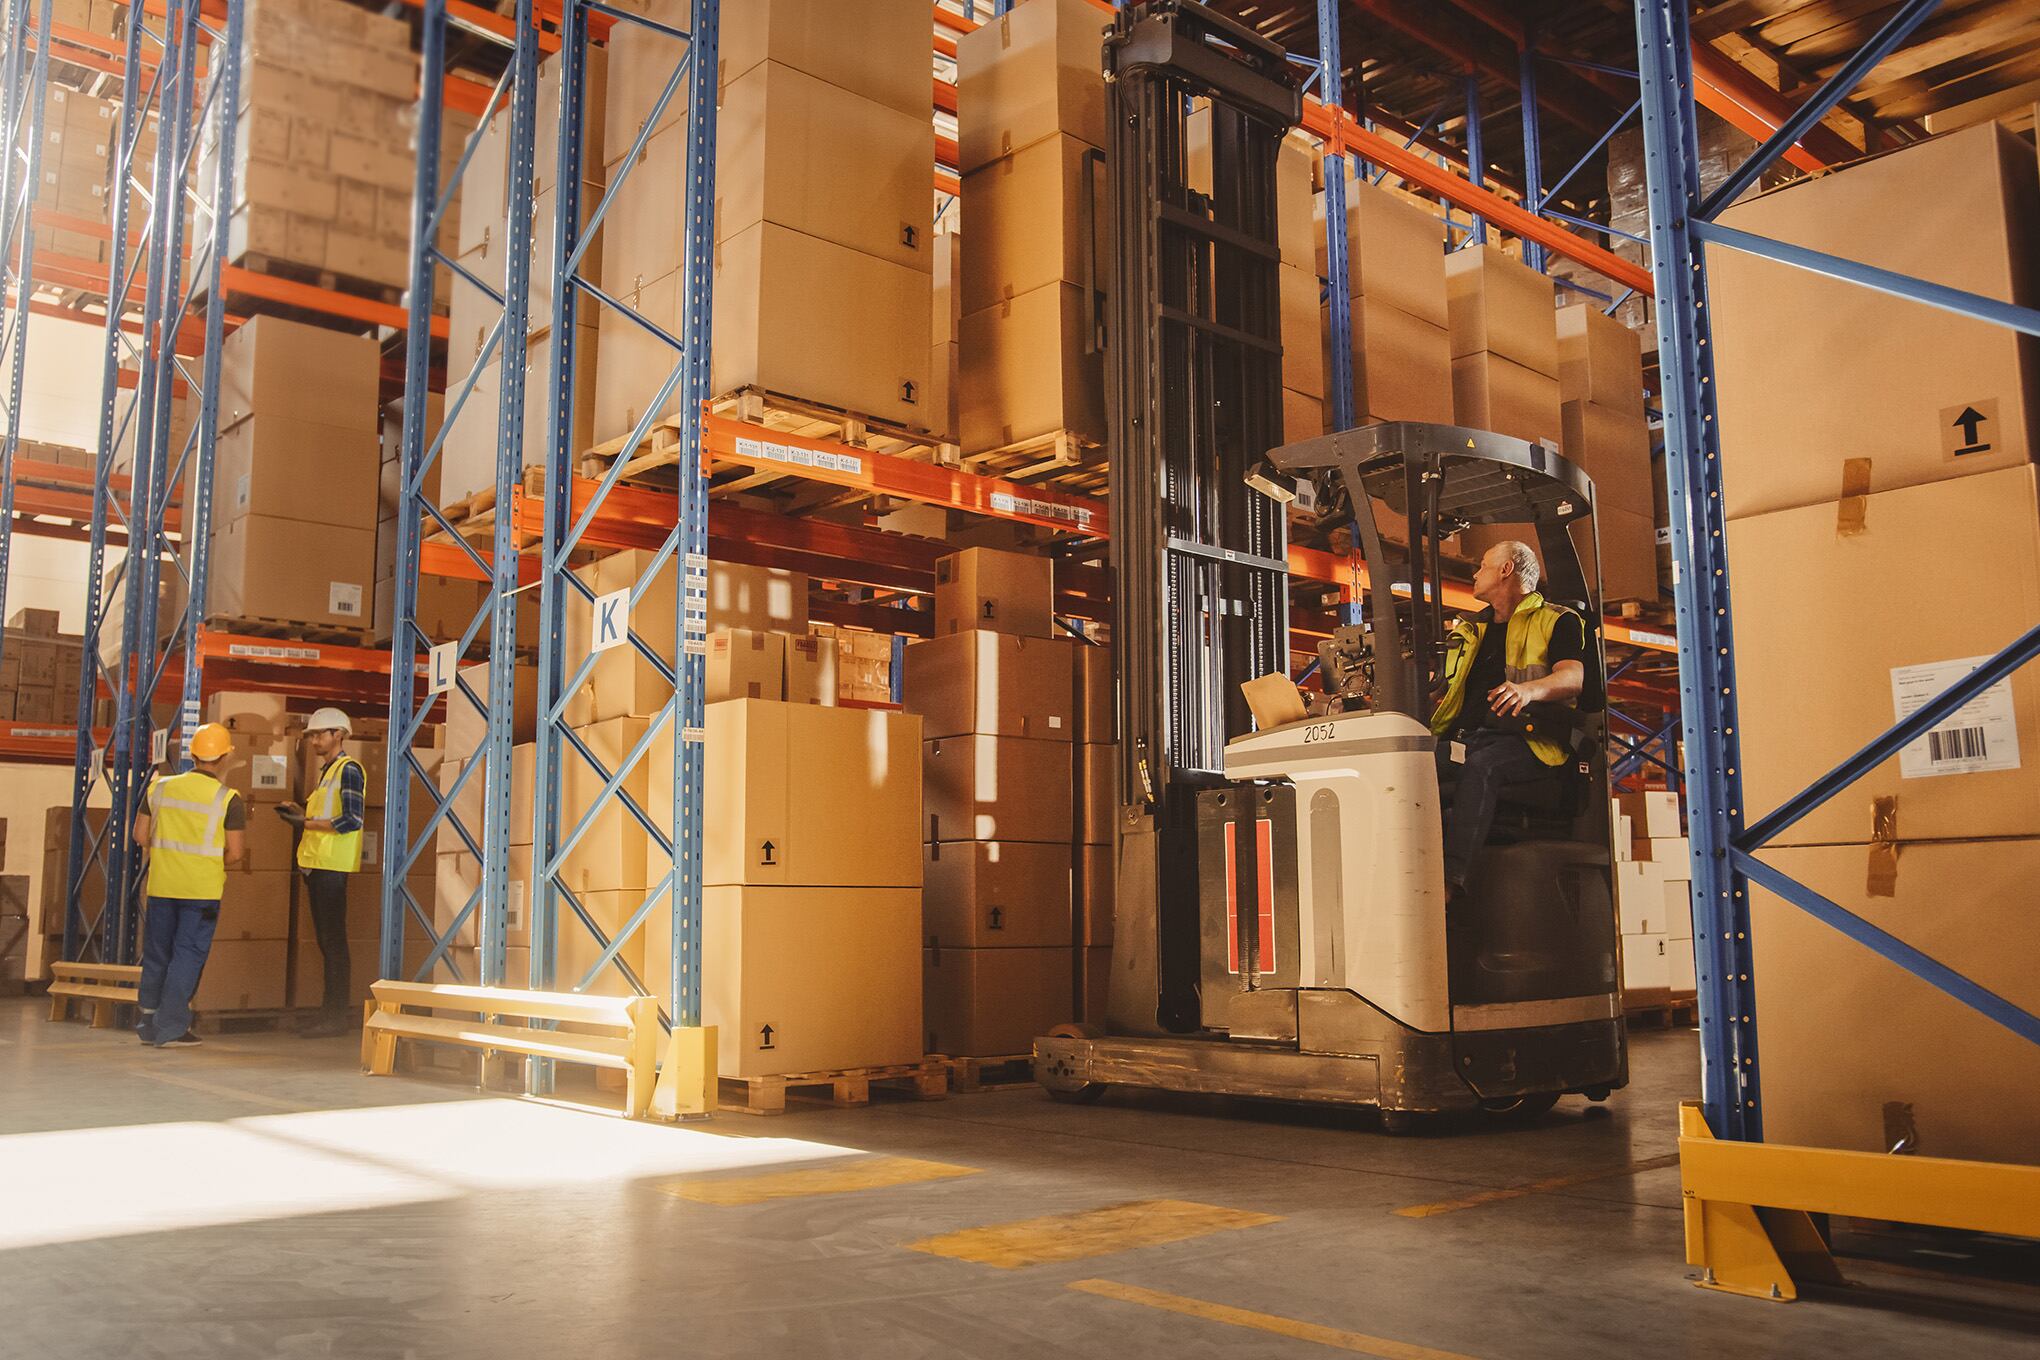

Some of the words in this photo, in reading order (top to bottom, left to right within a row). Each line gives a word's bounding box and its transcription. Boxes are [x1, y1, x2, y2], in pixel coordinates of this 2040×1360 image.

[601, 598, 618, 643] K
[436, 651, 446, 687] L
[1304, 722, 1335, 743] 2052
